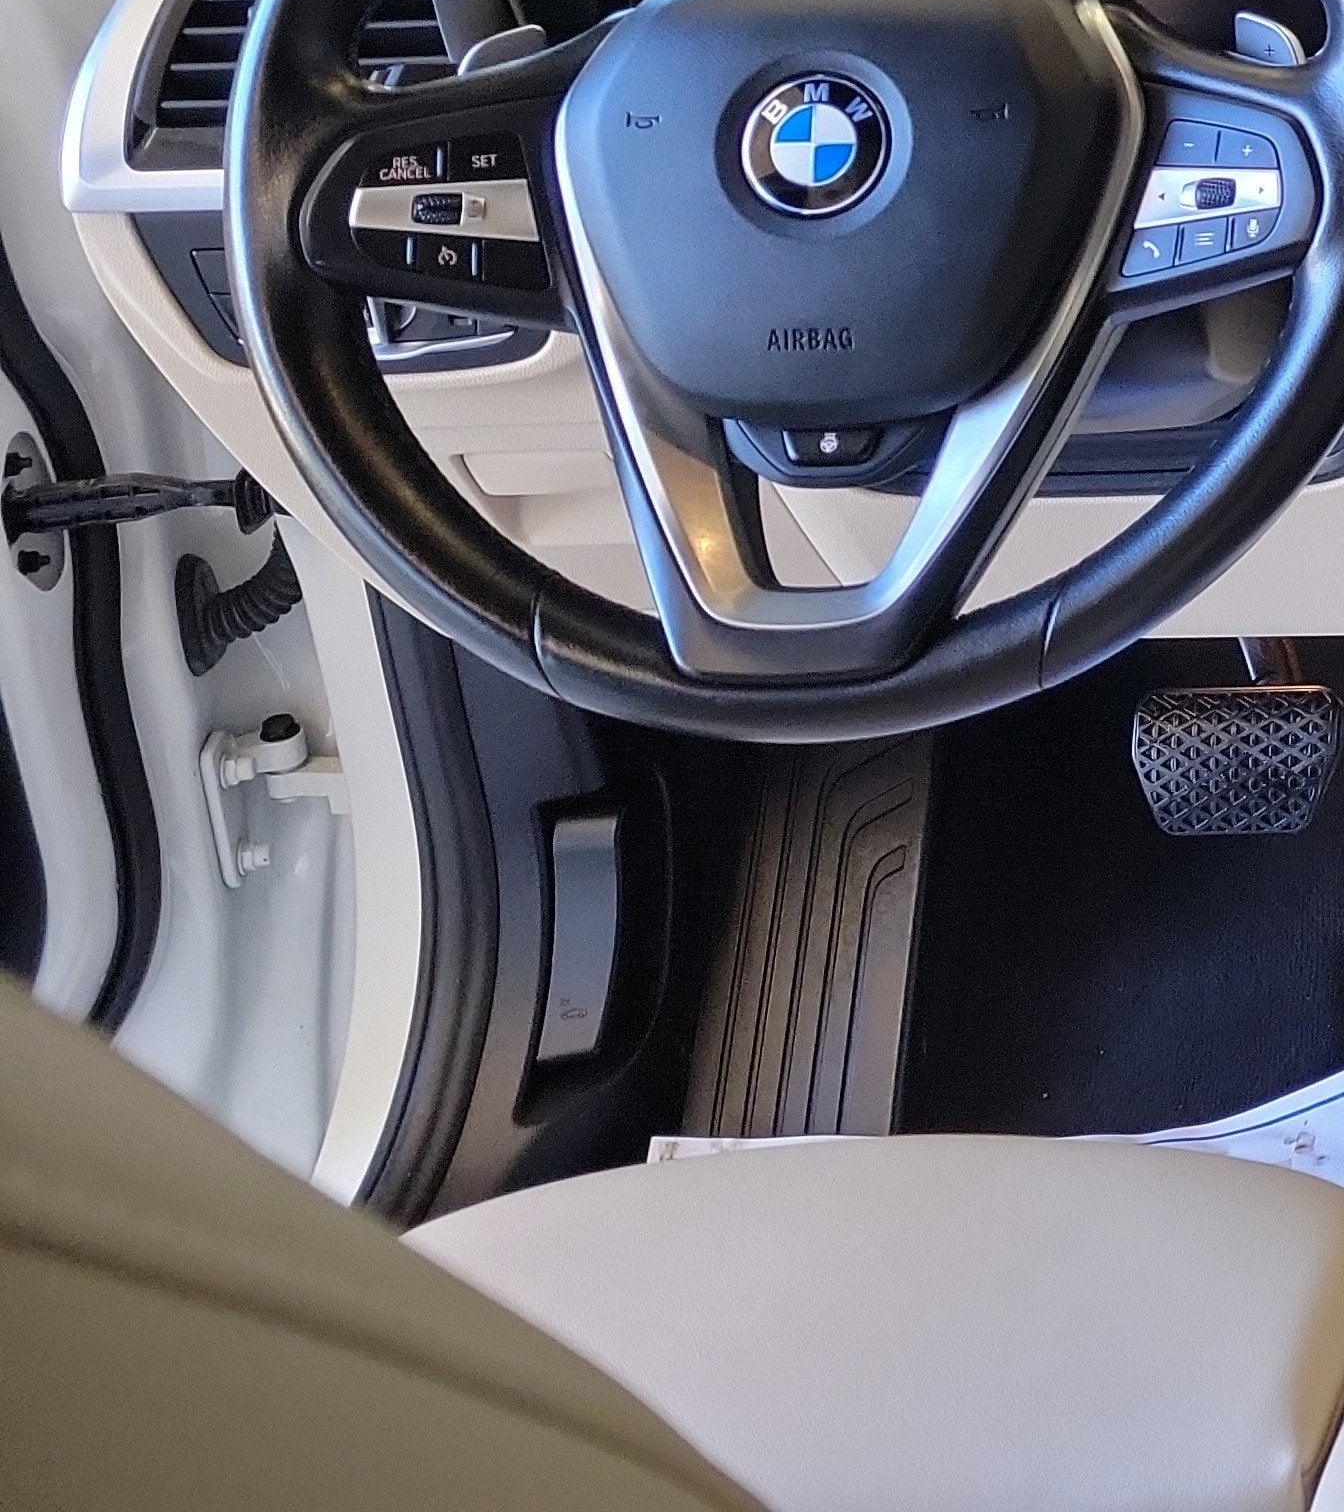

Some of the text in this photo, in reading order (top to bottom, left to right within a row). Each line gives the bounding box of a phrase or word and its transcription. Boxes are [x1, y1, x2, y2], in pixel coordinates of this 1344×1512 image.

[761, 83, 873, 123] BMW
[392, 155, 418, 169] RES
[471, 154, 498, 169] SET
[379, 166, 432, 181] CANCEL
[766, 327, 854, 352] AIRBAG
